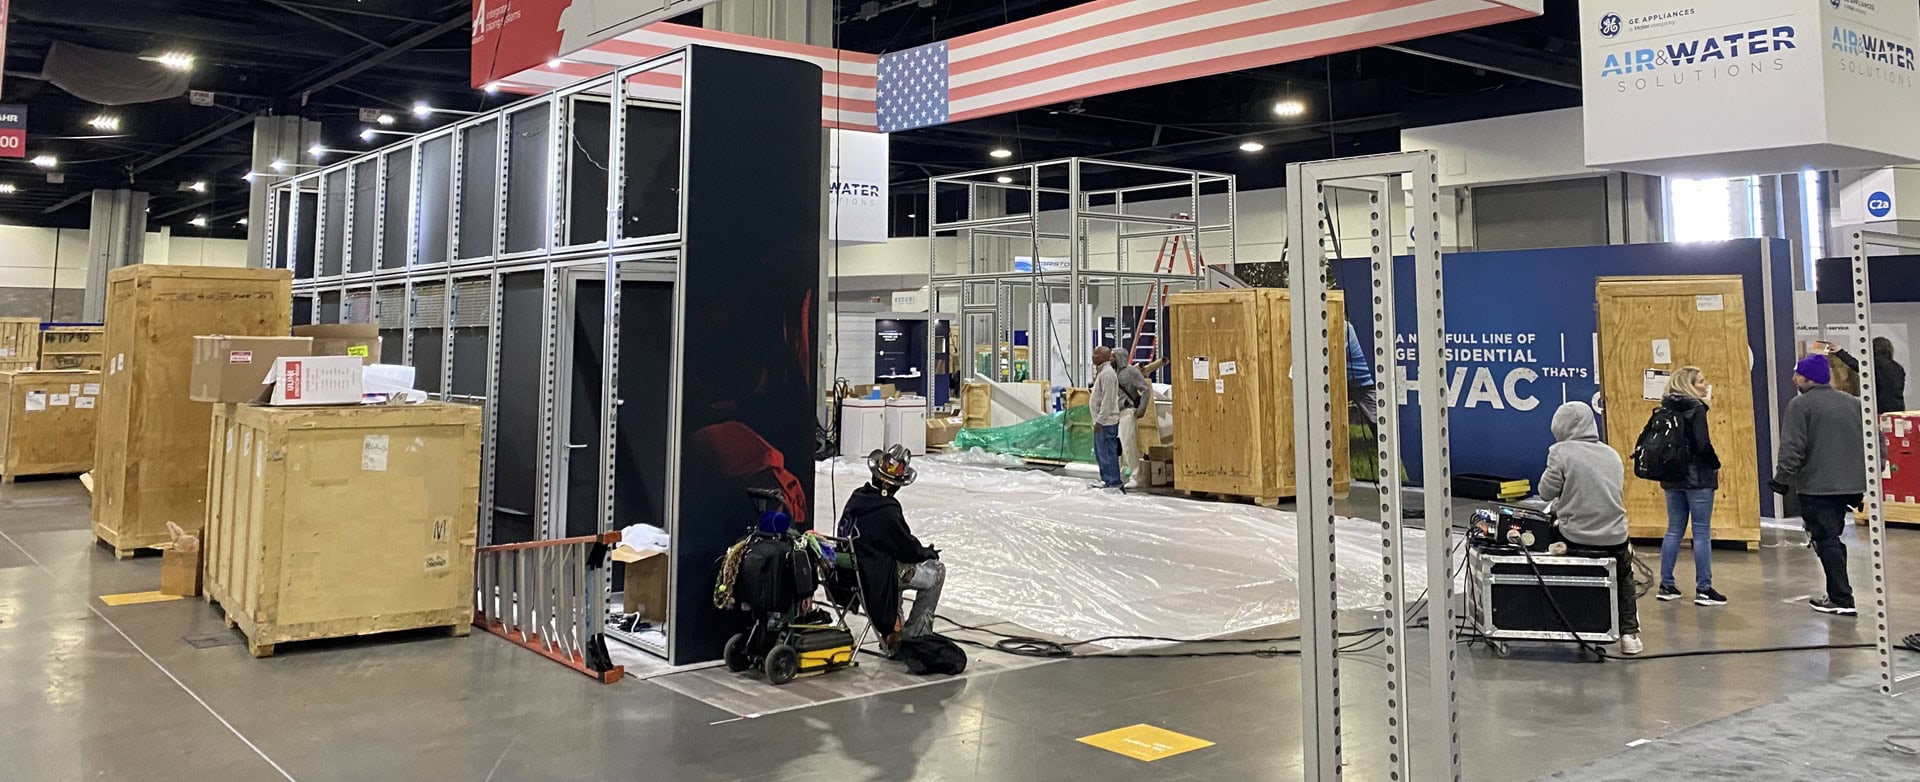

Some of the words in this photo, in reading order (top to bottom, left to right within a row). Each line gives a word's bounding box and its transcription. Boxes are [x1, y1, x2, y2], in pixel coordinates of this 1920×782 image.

[1642, 8, 1695, 23] APPLIANCES
[1617, 58, 1783, 92] SOLUTIONS
[1840, 58, 1912, 88] SOLUTIONS
[1869, 200, 1889, 209] C2a
[1396, 334, 1404, 344] A
[1445, 334, 1478, 344] FULL
[1481, 334, 1513, 344] LINE
[1516, 334, 1536, 344] OF
[1445, 348, 1537, 363] SIDENTIAL
[1656, 345, 1664, 357] 6
[287, 369, 295, 391] ULINE
[1541, 367, 1588, 378] THAT'S
[1396, 366, 1540, 411] HVAC
